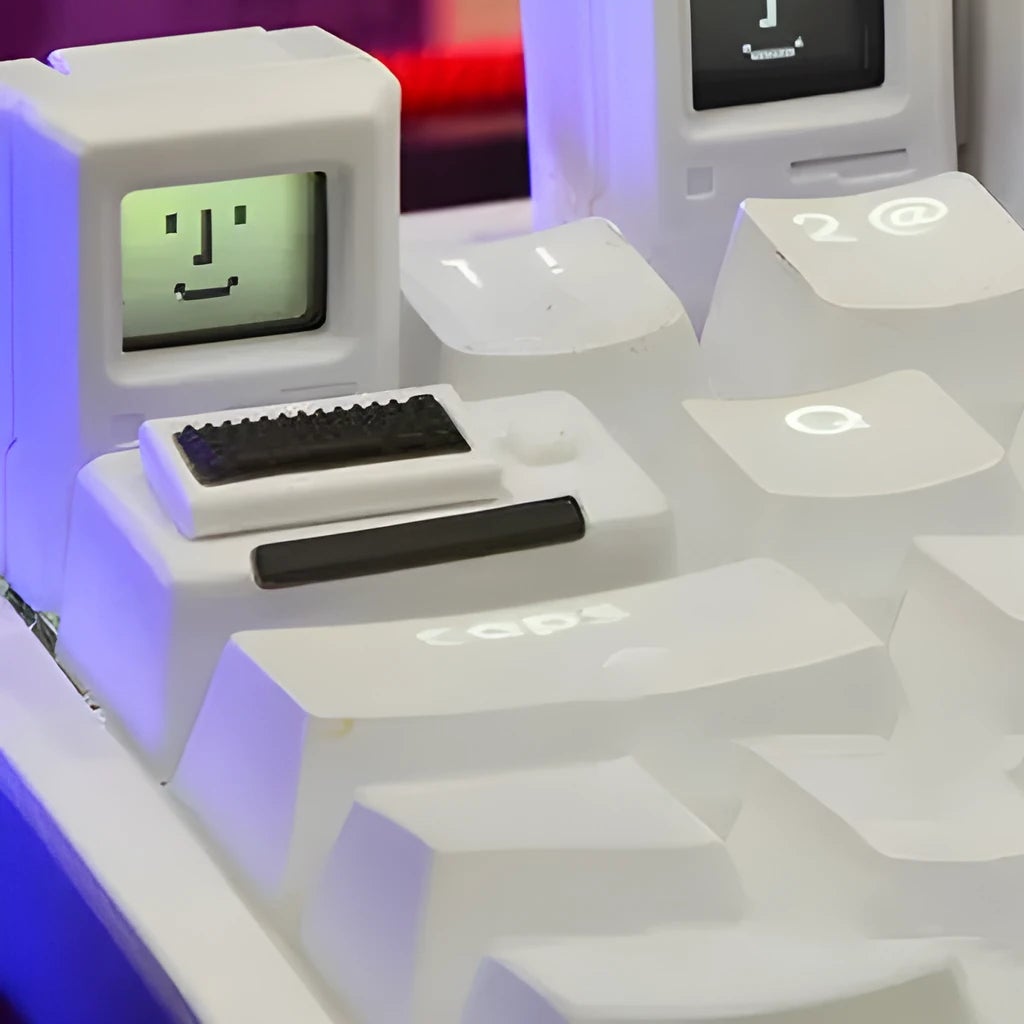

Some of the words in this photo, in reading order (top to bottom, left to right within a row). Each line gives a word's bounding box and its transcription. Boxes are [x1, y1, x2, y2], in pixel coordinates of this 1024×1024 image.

[792, 213, 858, 243] 2
[868, 196, 948, 236] @
[784, 405, 871, 435] Q
